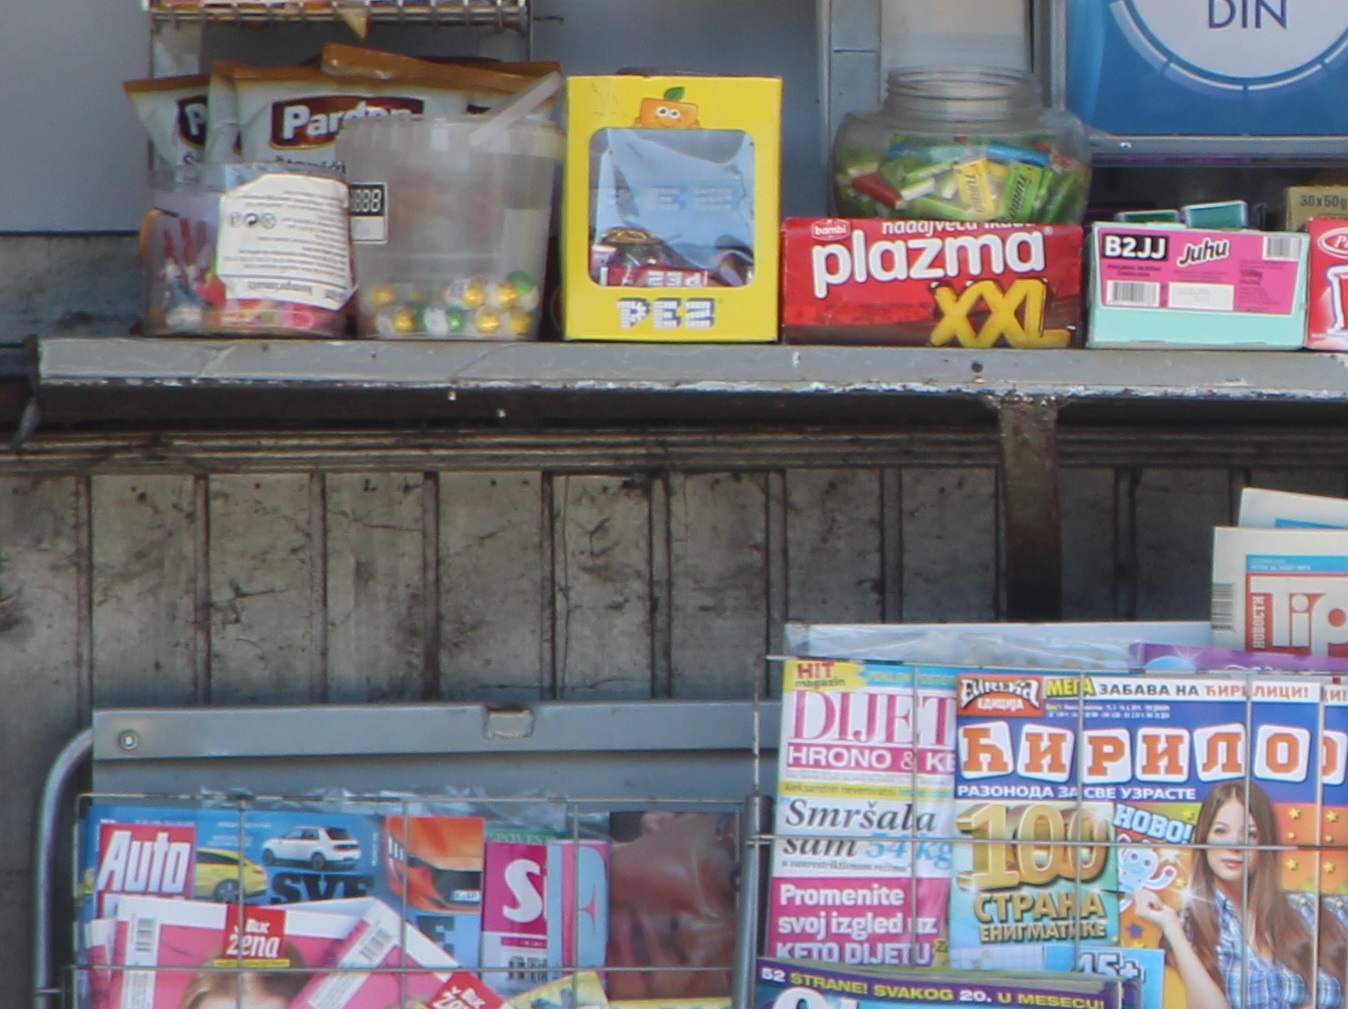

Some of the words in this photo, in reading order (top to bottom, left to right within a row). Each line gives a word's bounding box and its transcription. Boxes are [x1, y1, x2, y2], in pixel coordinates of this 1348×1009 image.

[1300, 194, 1348, 211] 30x50g
[814, 224, 848, 236] bambi
[1104, 235, 1167, 259] B2JJ
[1177, 238, 1230, 268] Juhu
[812, 229, 1046, 299] plazma
[616, 298, 716, 332] PEZ
[929, 279, 1071, 348] XXL
[797, 661, 836, 679] HIT
[1100, 682, 1169, 697] ЗАБАВА
[1176, 684, 1200, 697] НА
[787, 745, 893, 769] HRONO
[961, 726, 1301, 776] ЋИРИЛО
[957, 784, 1054, 800] РАЗОНОДА
[1084, 787, 1117, 801] СВЕ
[1120, 786, 1197, 801] УЗРАСТЕ
[786, 798, 937, 832] Smršala
[1112, 802, 1194, 846] НОВО!
[97, 829, 192, 893] Auto
[957, 802, 1108, 890] 100
[779, 884, 905, 907] Promenite
[973, 891, 1105, 923] СТРАНА
[778, 914, 827, 940] svoj
[830, 912, 903, 940] izgled
[226, 926, 281, 959] žena
[761, 968, 786, 984] 52
[790, 972, 868, 995] STRANE!
[873, 984, 955, 1002] SVAKOG
[959, 989, 993, 1004] 20.
[997, 991, 1012, 1003] U
[1017, 993, 1105, 1009] MESECU!
